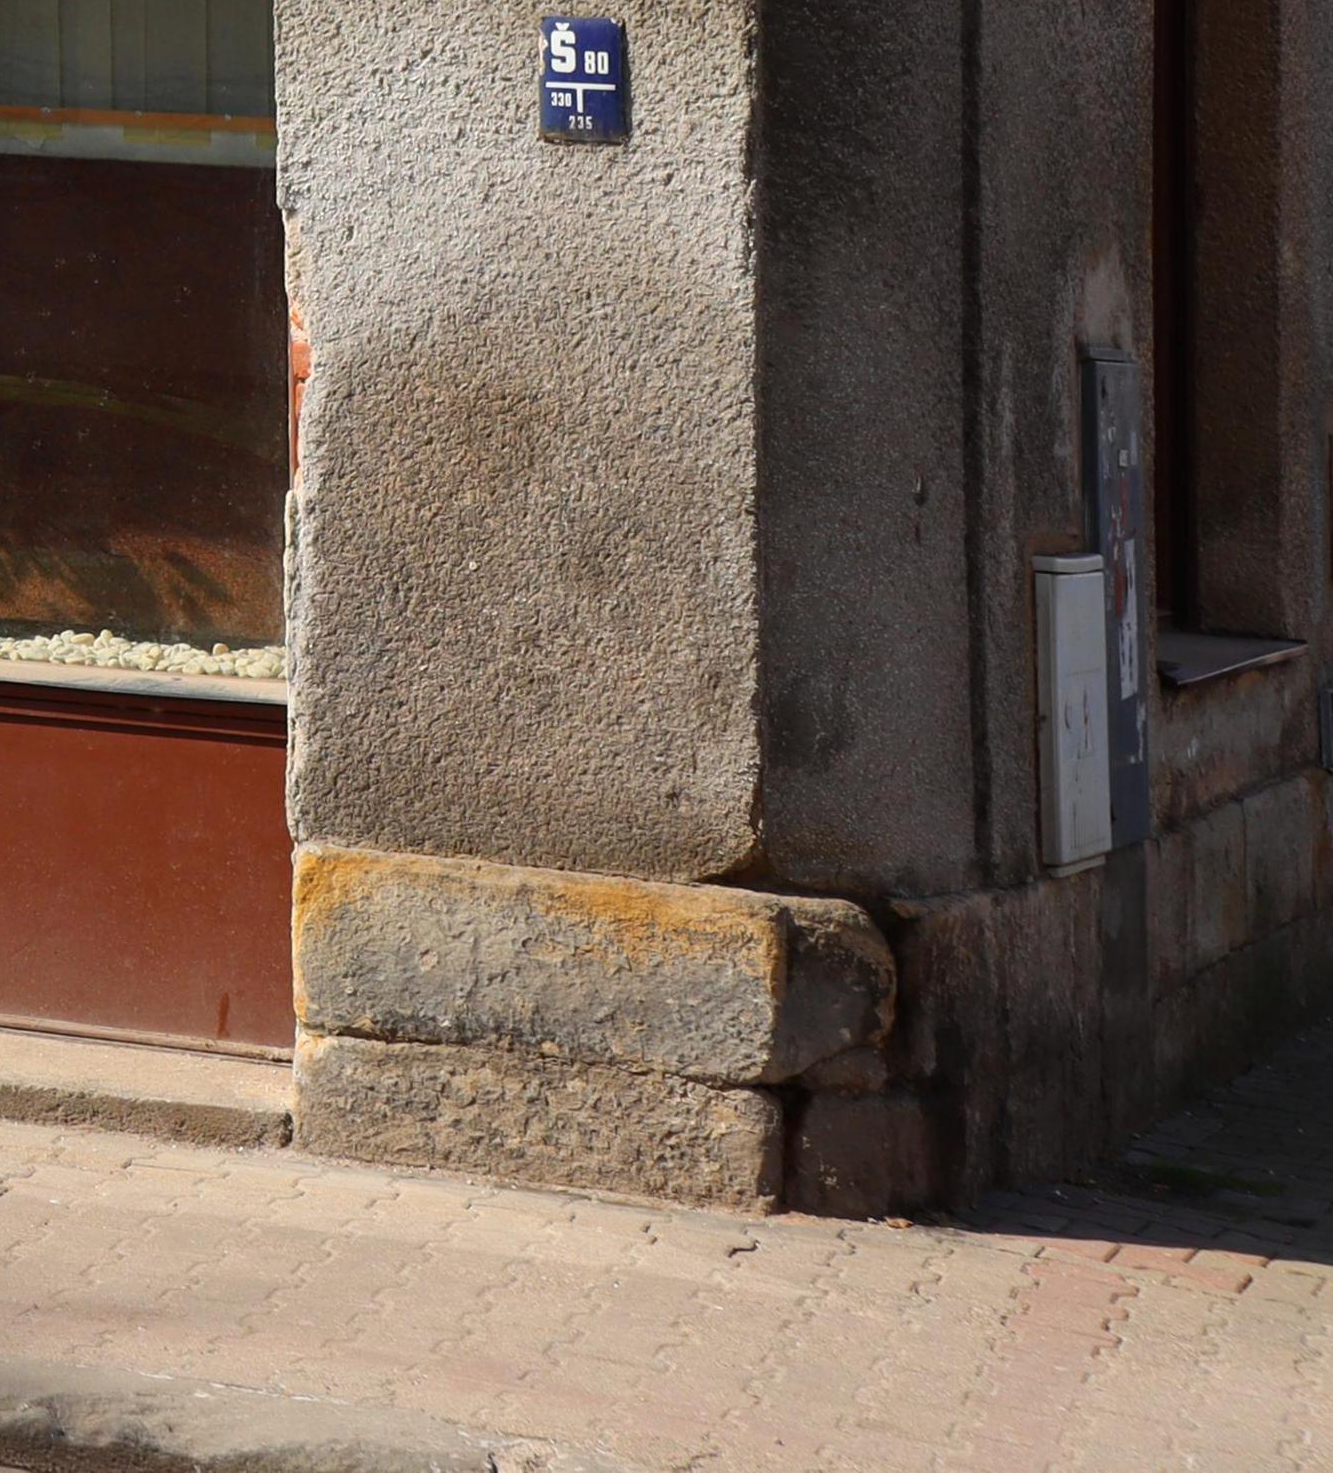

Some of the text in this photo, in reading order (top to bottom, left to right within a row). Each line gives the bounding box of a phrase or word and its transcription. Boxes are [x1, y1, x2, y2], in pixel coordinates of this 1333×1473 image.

[550, 21, 610, 76] Š 80
[550, 92, 573, 108] 330
[568, 115, 594, 130] 235
